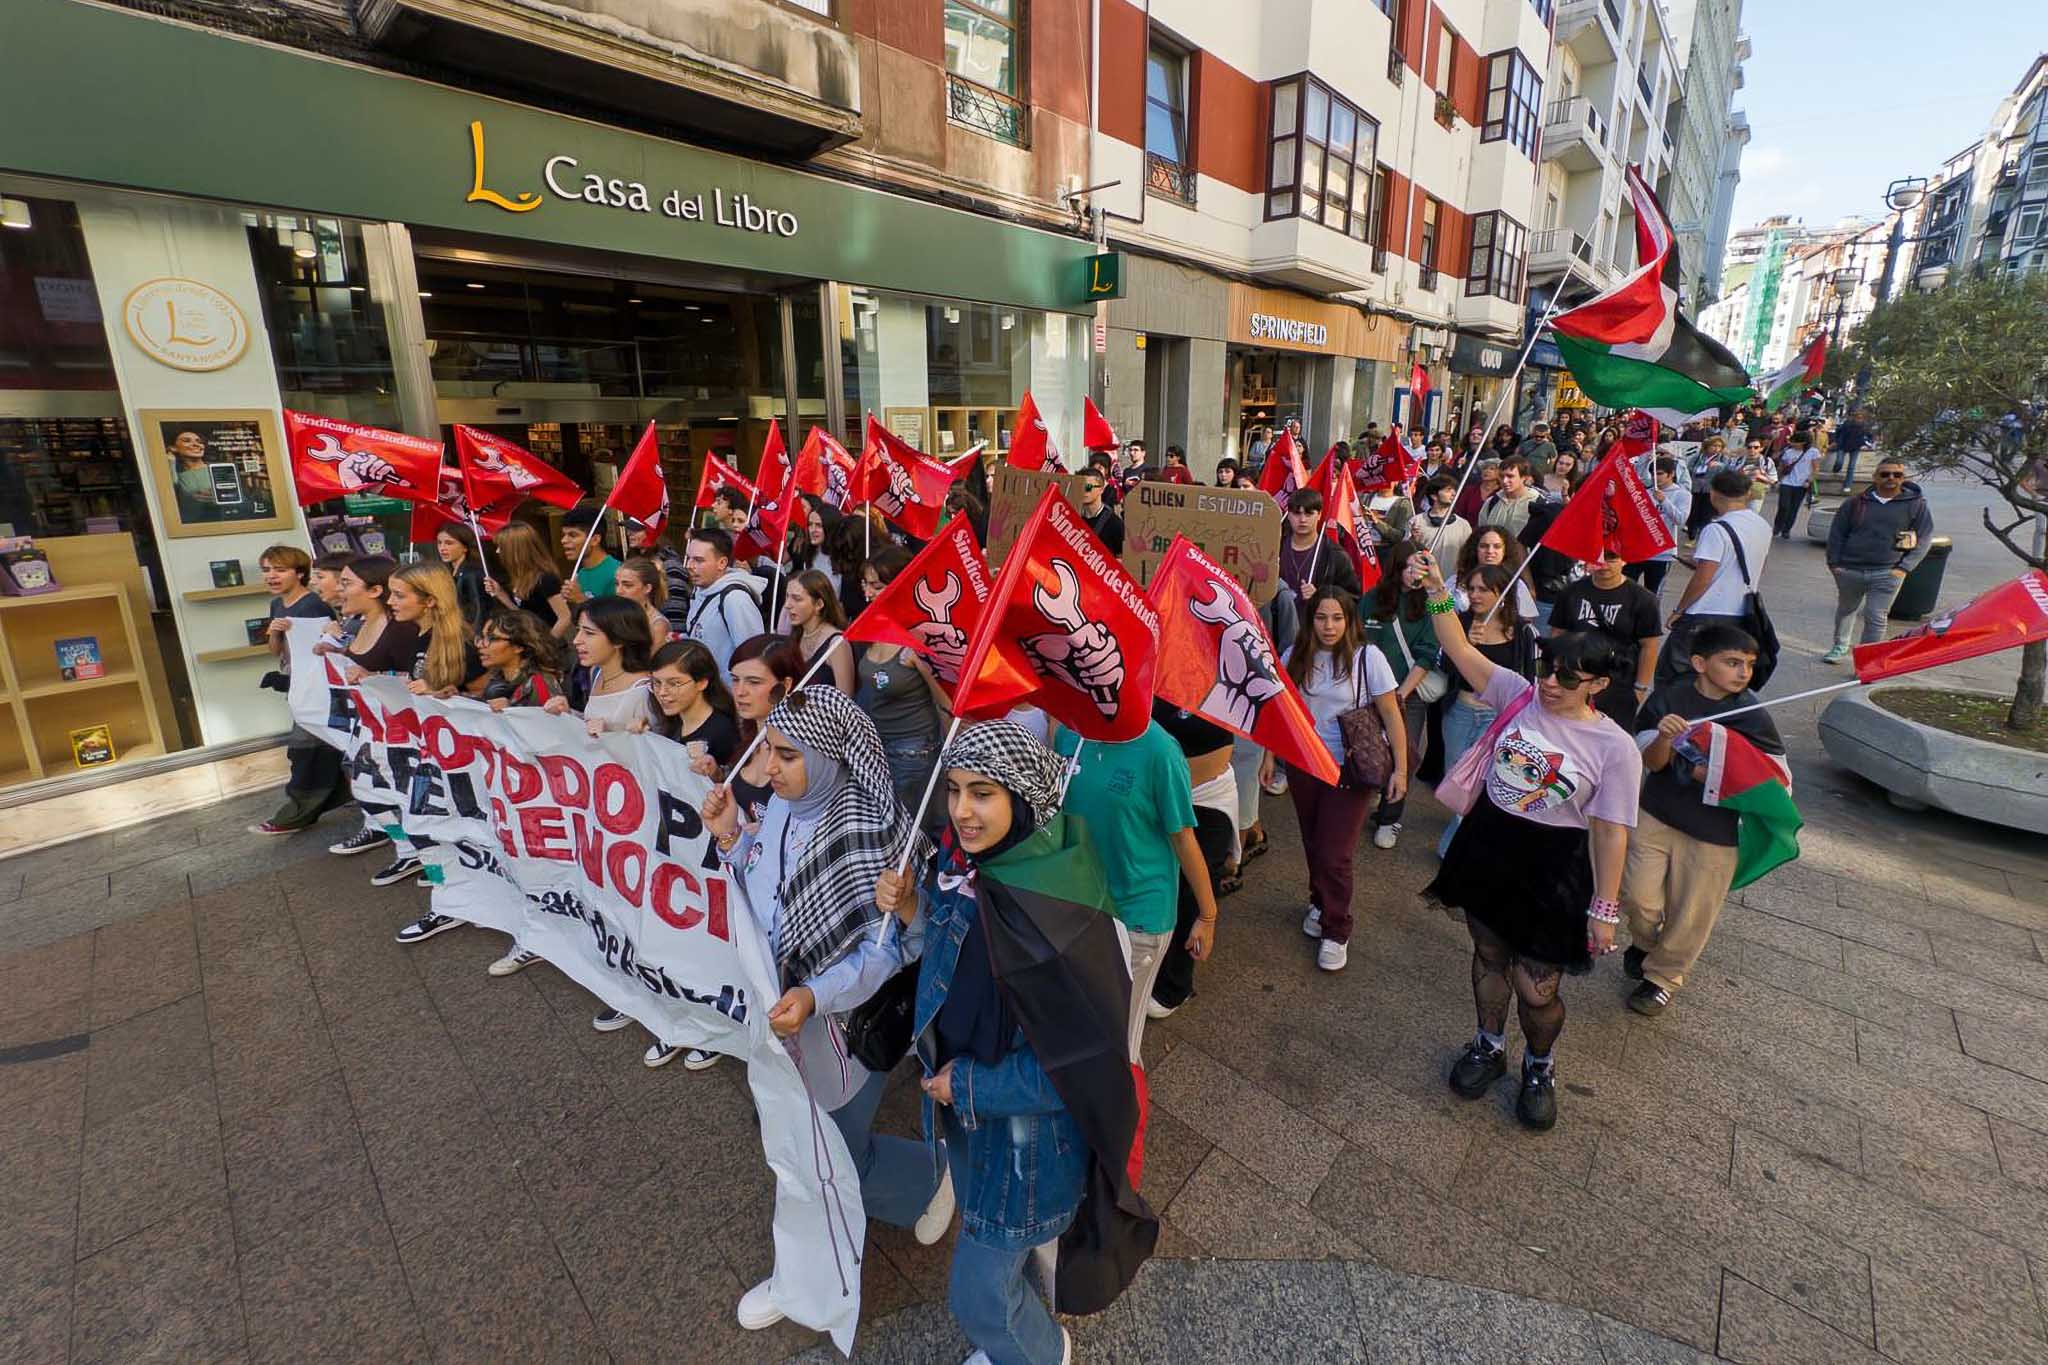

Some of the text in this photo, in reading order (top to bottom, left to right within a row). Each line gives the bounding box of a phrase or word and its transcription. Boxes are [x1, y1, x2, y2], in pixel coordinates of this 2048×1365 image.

[545, 155, 799, 238] Casa del Libro
[1250, 312, 1328, 346] SPRINGFIELD
[293, 413, 355, 436] Sindicato
[369, 430, 439, 452] Estudiantes
[1141, 487, 1264, 517] QUIEN ESTUDIA
[1047, 501, 1107, 576] Sindicato
[1103, 569, 1123, 594] de
